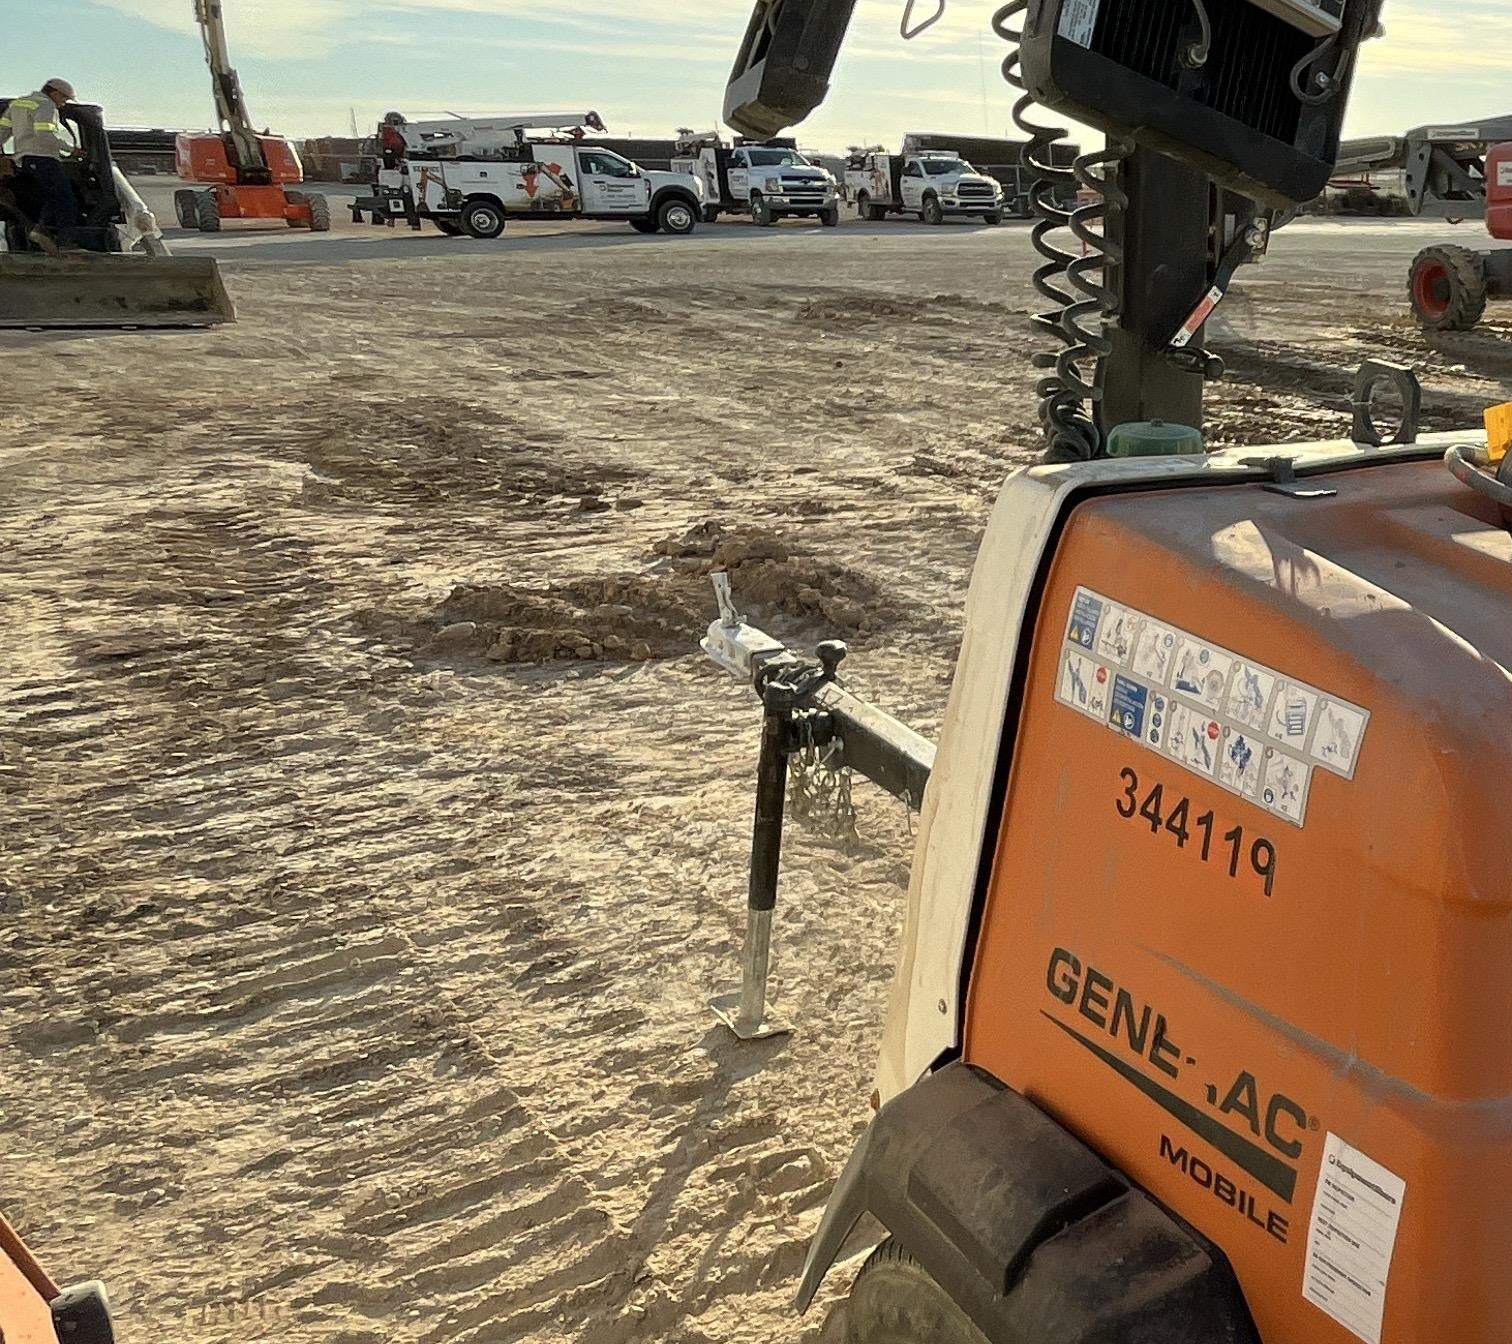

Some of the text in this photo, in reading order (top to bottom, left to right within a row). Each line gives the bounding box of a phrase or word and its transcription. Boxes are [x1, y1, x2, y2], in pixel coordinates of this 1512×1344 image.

[1115, 767, 1277, 897] 344119
[1046, 947, 1307, 1160] GENEAC
[1160, 1134, 1289, 1244] MOBILE
